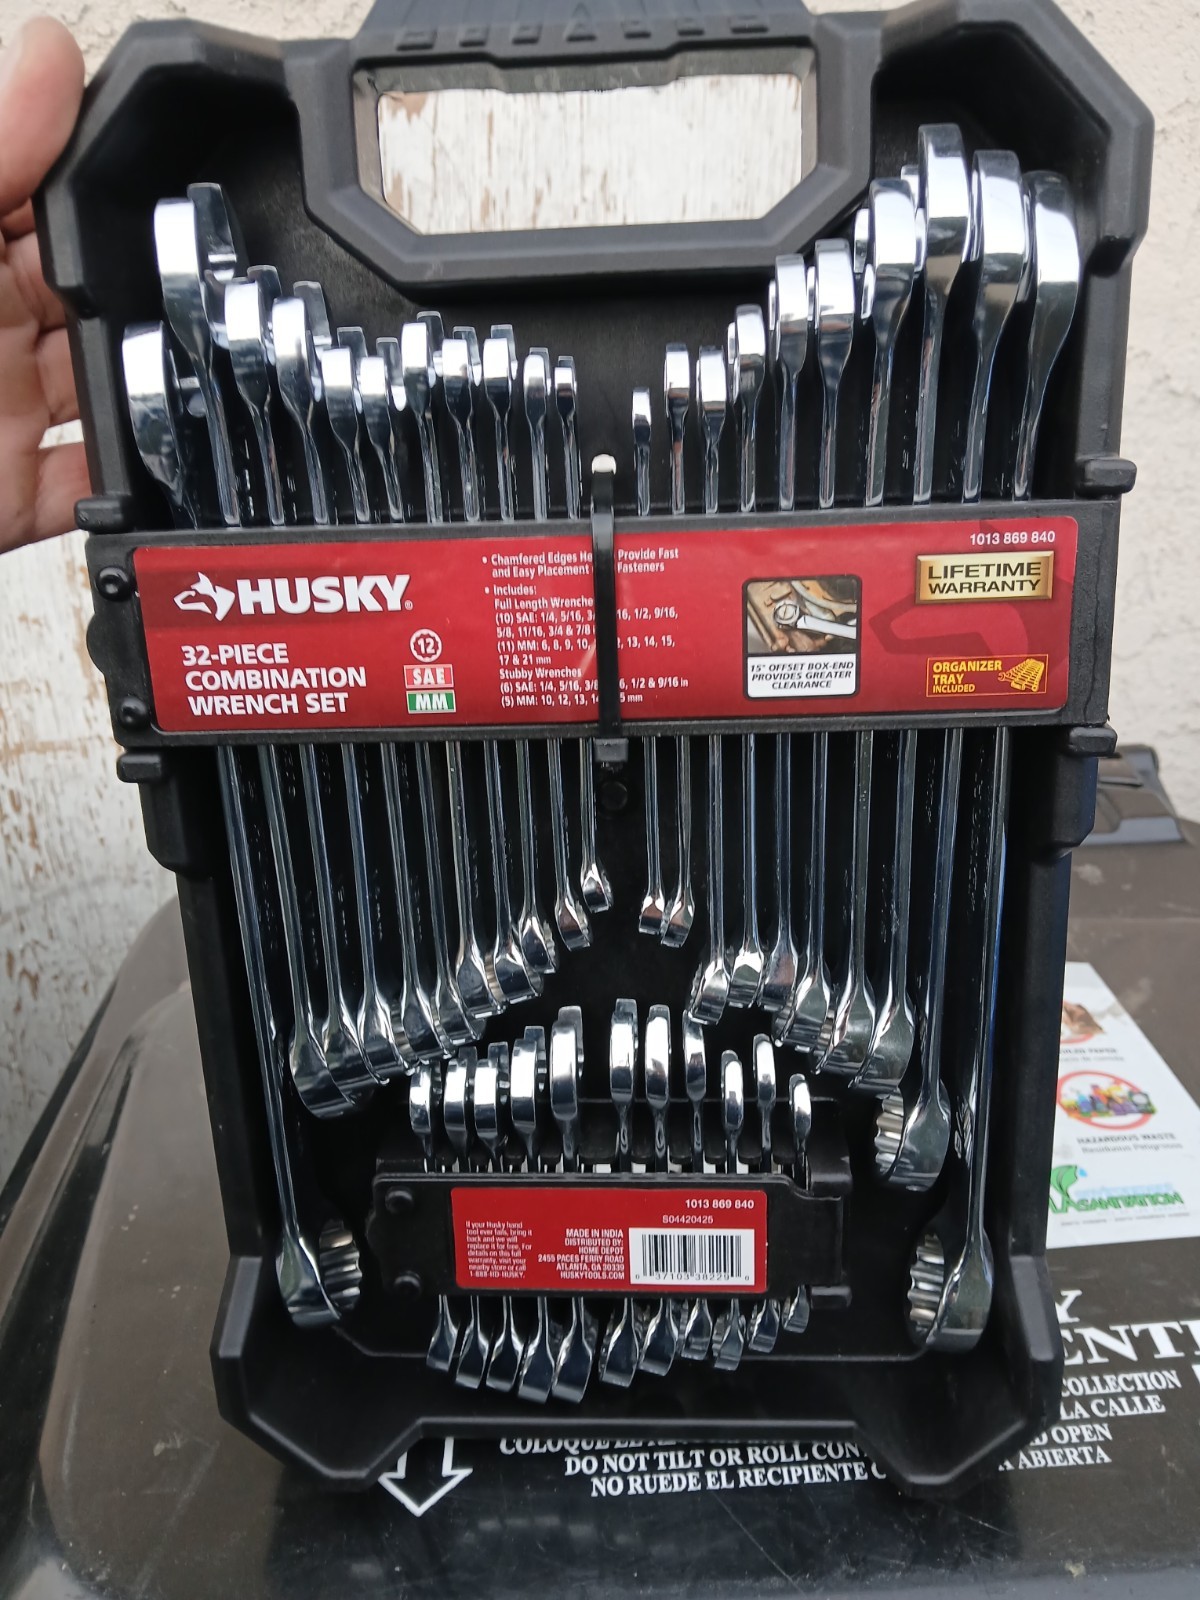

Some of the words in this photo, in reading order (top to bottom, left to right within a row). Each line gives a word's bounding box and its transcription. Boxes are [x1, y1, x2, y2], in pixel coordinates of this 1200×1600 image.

[970, 532, 1000, 546] 1013
[1004, 532, 1027, 545] 869
[1031, 531, 1055, 543] 840
[491, 552, 545, 566] Chamfered
[548, 551, 577, 565] Edges
[618, 548, 655, 560] Provide
[659, 548, 678, 559] Fast
[492, 566, 510, 578] and
[513, 566, 535, 580] Easy
[538, 564, 590, 576] Placement
[618, 562, 664, 573] Fasteners
[928, 561, 1041, 579] LIFETIME
[494, 584, 536, 596] Includes:
[928, 579, 1041, 594] WARRANTY
[494, 598, 512, 610] Full
[514, 597, 548, 611] Length
[550, 595, 594, 608] Wrenche
[496, 612, 514, 626] (10)
[516, 612, 538, 624] SAE:
[540, 612, 558, 624] 1/4,
[560, 610, 584, 622] 5/16,
[634, 608, 651, 620] 1/2,
[654, 606, 678, 619] 9/16,
[496, 627, 514, 639] 5/8,
[518, 626, 545, 638] 11/16,
[548, 625, 563, 636] 3/4
[566, 625, 573, 636] &
[576, 624, 590, 635] 7/8
[418, 638, 435, 654] 12
[498, 641, 514, 654] (11)
[517, 640, 539, 651] MM:
[542, 639, 550, 652] 6,
[553, 639, 562, 651] 8,
[565, 639, 573, 651] 9,
[577, 638, 590, 650] 10,
[627, 636, 640, 648] 13,
[644, 636, 658, 648] 14,
[662, 635, 675, 647] 15,
[181, 642, 289, 666] 32-PIECE
[499, 654, 509, 666] 17
[512, 654, 520, 665] &
[522, 654, 533, 665] 21
[536, 656, 551, 664] mm
[499, 667, 533, 681] Stubby
[535, 666, 582, 678] Wrenches
[768, 663, 805, 672] OFFSET
[807, 661, 854, 670] BOX-END
[933, 660, 1002, 673] ORGANIZER
[185, 667, 367, 691] COMBINATION
[413, 667, 445, 686] SAE
[752, 672, 802, 681] PROVIDES
[805, 671, 852, 679] GREATER
[933, 674, 964, 685] TRAY
[500, 681, 513, 694] (6)
[515, 681, 537, 692] SAE:
[540, 681, 556, 692] 1/4,
[559, 680, 582, 692] 5/16,
[631, 677, 645, 689] 1/2
[648, 677, 655, 688] &
[658, 676, 678, 688] 9/16
[680, 677, 688, 687] in
[772, 680, 832, 689] CLEARANCE
[933, 684, 975, 694] INCLUDED
[187, 694, 299, 716] WRENCH
[306, 692, 349, 713] SET
[416, 693, 448, 710] MM
[502, 695, 514, 708] (5)
[516, 695, 538, 706] MM:
[541, 694, 555, 706] 10,
[558, 694, 571, 706] 12,
[574, 694, 587, 706] 13,
[627, 694, 643, 702] mm
[685, 1199, 709, 1208] 1013
[712, 1199, 732, 1208] 869
[735, 1199, 754, 1209] 840
[486, 1221, 506, 1229] Husky
[510, 1229, 526, 1237] bring
[566, 1228, 590, 1238] MADE
[592, 1228, 599, 1238] IN
[602, 1228, 623, 1238] INDIA
[565, 1238, 611, 1246] DISTRIBUTED
[612, 1238, 623, 1246] BY:
[579, 1246, 599, 1254] HOME
[601, 1246, 623, 1254] DEPOT
[557, 1254, 579, 1262] PACES
[581, 1255, 603, 1263] FERRY
[605, 1255, 624, 1263] ROAD
[556, 1262, 590, 1271] ATLANTA,
[592, 1263, 601, 1271] GA
[603, 1263, 624, 1271] 30339
[561, 1271, 624, 1280] HUSKYTOOLS.COM
[656, 1273, 690, 1281] 37103
[696, 1273, 730, 1281] 38229
[1090, 1394, 1166, 1418] CALLE
[1051, 1423, 1113, 1444] OPEN
[564, 1455, 598, 1476] DO
[602, 1452, 650, 1474] NOT
[654, 1449, 704, 1470] TILT
[710, 1447, 744, 1467] OR
[747, 1442, 808, 1464] ROLL
[1018, 1445, 1112, 1470] ABIERTA
[591, 1476, 623, 1497] NO
[627, 1470, 701, 1495] RUEDE
[705, 1469, 734, 1489] EL
[737, 1462, 868, 1488] RECIPIENTE
